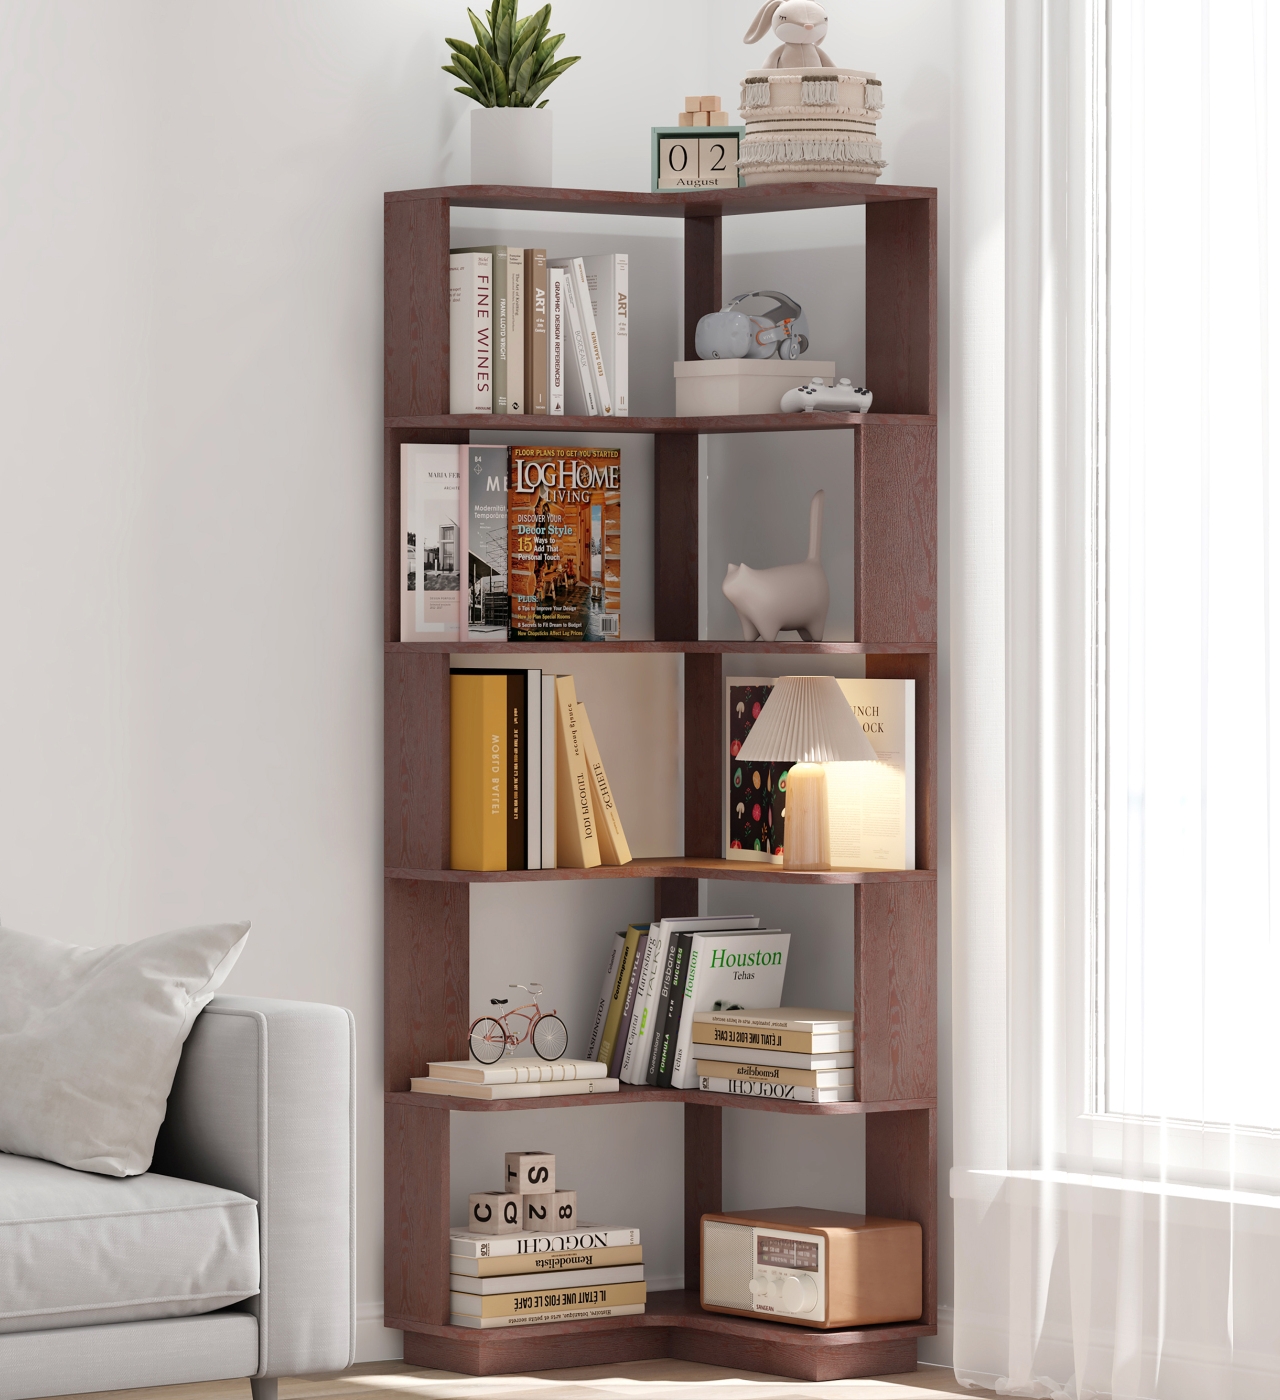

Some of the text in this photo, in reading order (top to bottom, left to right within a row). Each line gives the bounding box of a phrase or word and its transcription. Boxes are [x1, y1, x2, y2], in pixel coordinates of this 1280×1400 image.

[676, 178, 718, 188] August
[478, 275, 489, 318] FINE
[536, 288, 545, 314] ART
[618, 292, 627, 318] ART
[575, 330, 587, 367] BORDEAUX
[478, 328, 489, 392] WINES
[546, 490, 590, 502] LIVING
[547, 514, 562, 522] YOUR
[518, 525, 572, 537] Decor Style
[518, 537, 532, 552] 15
[862, 722, 884, 733] OCK
[647, 940, 661, 996] TALKS
[710, 949, 782, 968] Houston
[614, 946, 629, 1000] Contemporan
[623, 951, 641, 1016] FORM STYLE
[685, 950, 698, 998] Houston
[733, 971, 755, 980] Tehas
[623, 937, 656, 1070] State Capital Harrisburg
[650, 946, 676, 1074] Queensland Brisbane
[660, 1034, 670, 1073] FORMULA
[673, 948, 683, 986] SUCCESS
[587, 998, 605, 1059] WASHINGTON
[508, 1164, 517, 1182] T
[528, 1166, 548, 1184] S
[474, 1203, 492, 1222] C
[504, 1201, 517, 1224] Q
[529, 1204, 546, 1220] 2
[559, 1204, 572, 1219] 8
[517, 1232, 608, 1254] NOGUCHI
[535, 1255, 593, 1268] Remodelista
[514, 1290, 606, 1312] IL ÉTAIT UNE FOIS LE CAFÉ
[756, 1304, 774, 1312] SANGEAN
